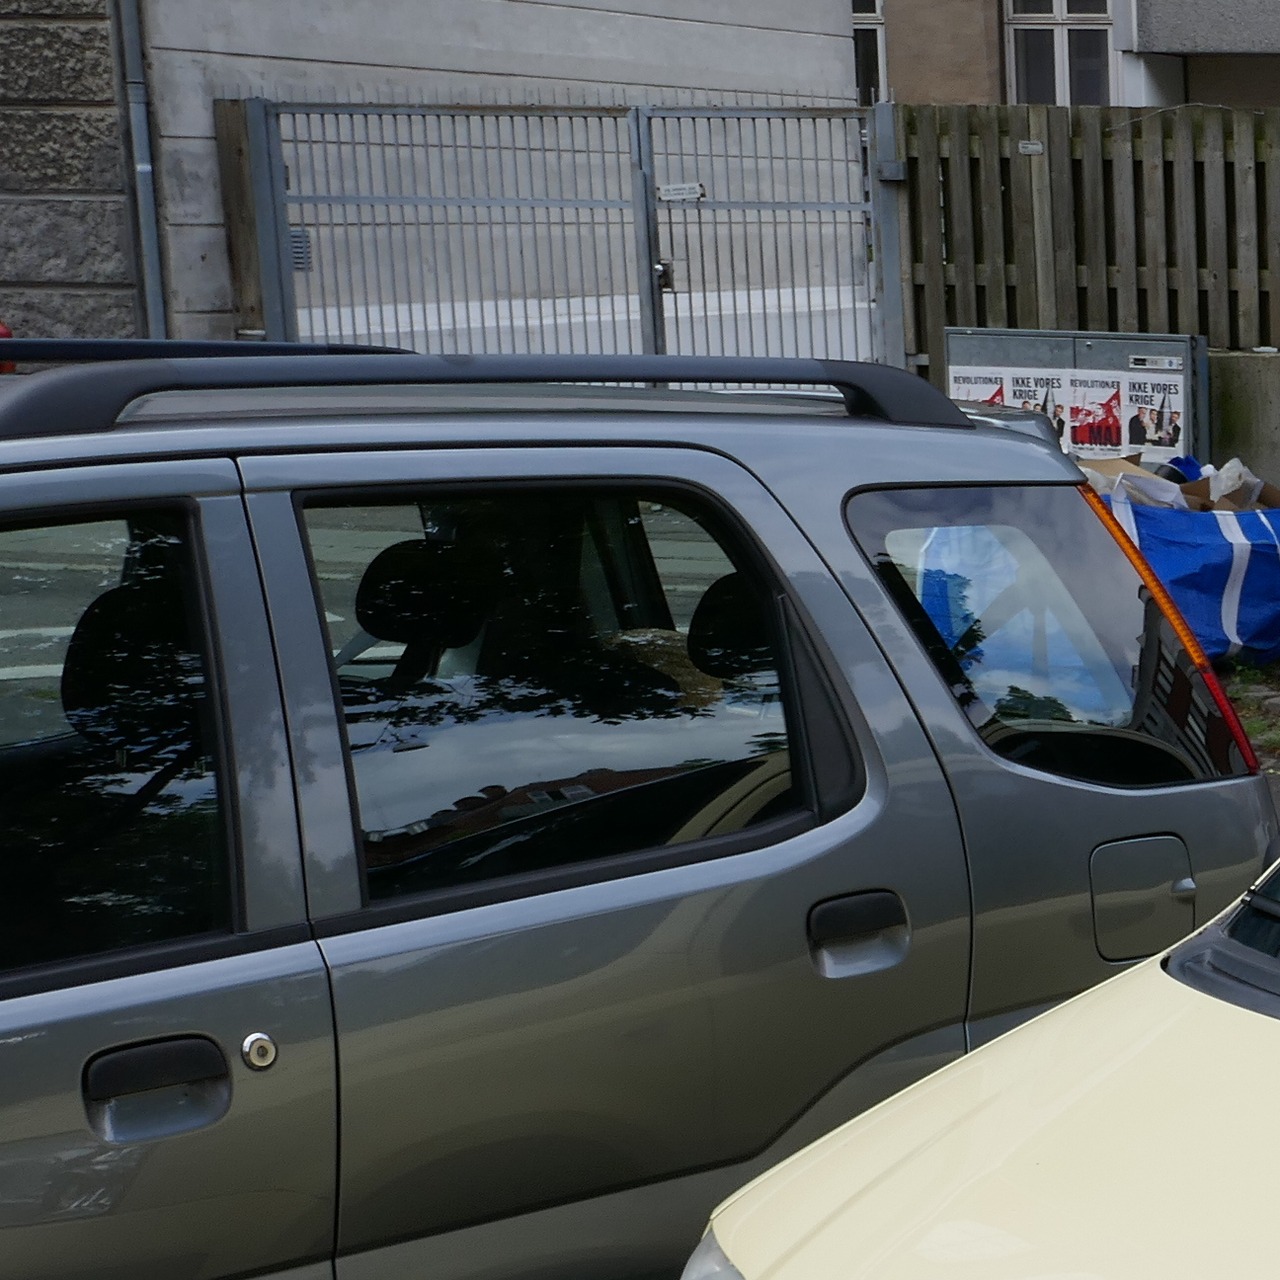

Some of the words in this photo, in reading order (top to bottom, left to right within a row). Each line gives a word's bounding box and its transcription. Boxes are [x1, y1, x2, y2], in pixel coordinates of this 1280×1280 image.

[1012, 376, 1031, 388] IKKE
[1034, 377, 1061, 389] VORES
[1129, 381, 1148, 393] IKKE
[1151, 382, 1179, 395] VORES
[1012, 389, 1039, 401] KRIGE
[1129, 394, 1155, 406] KRIGE
